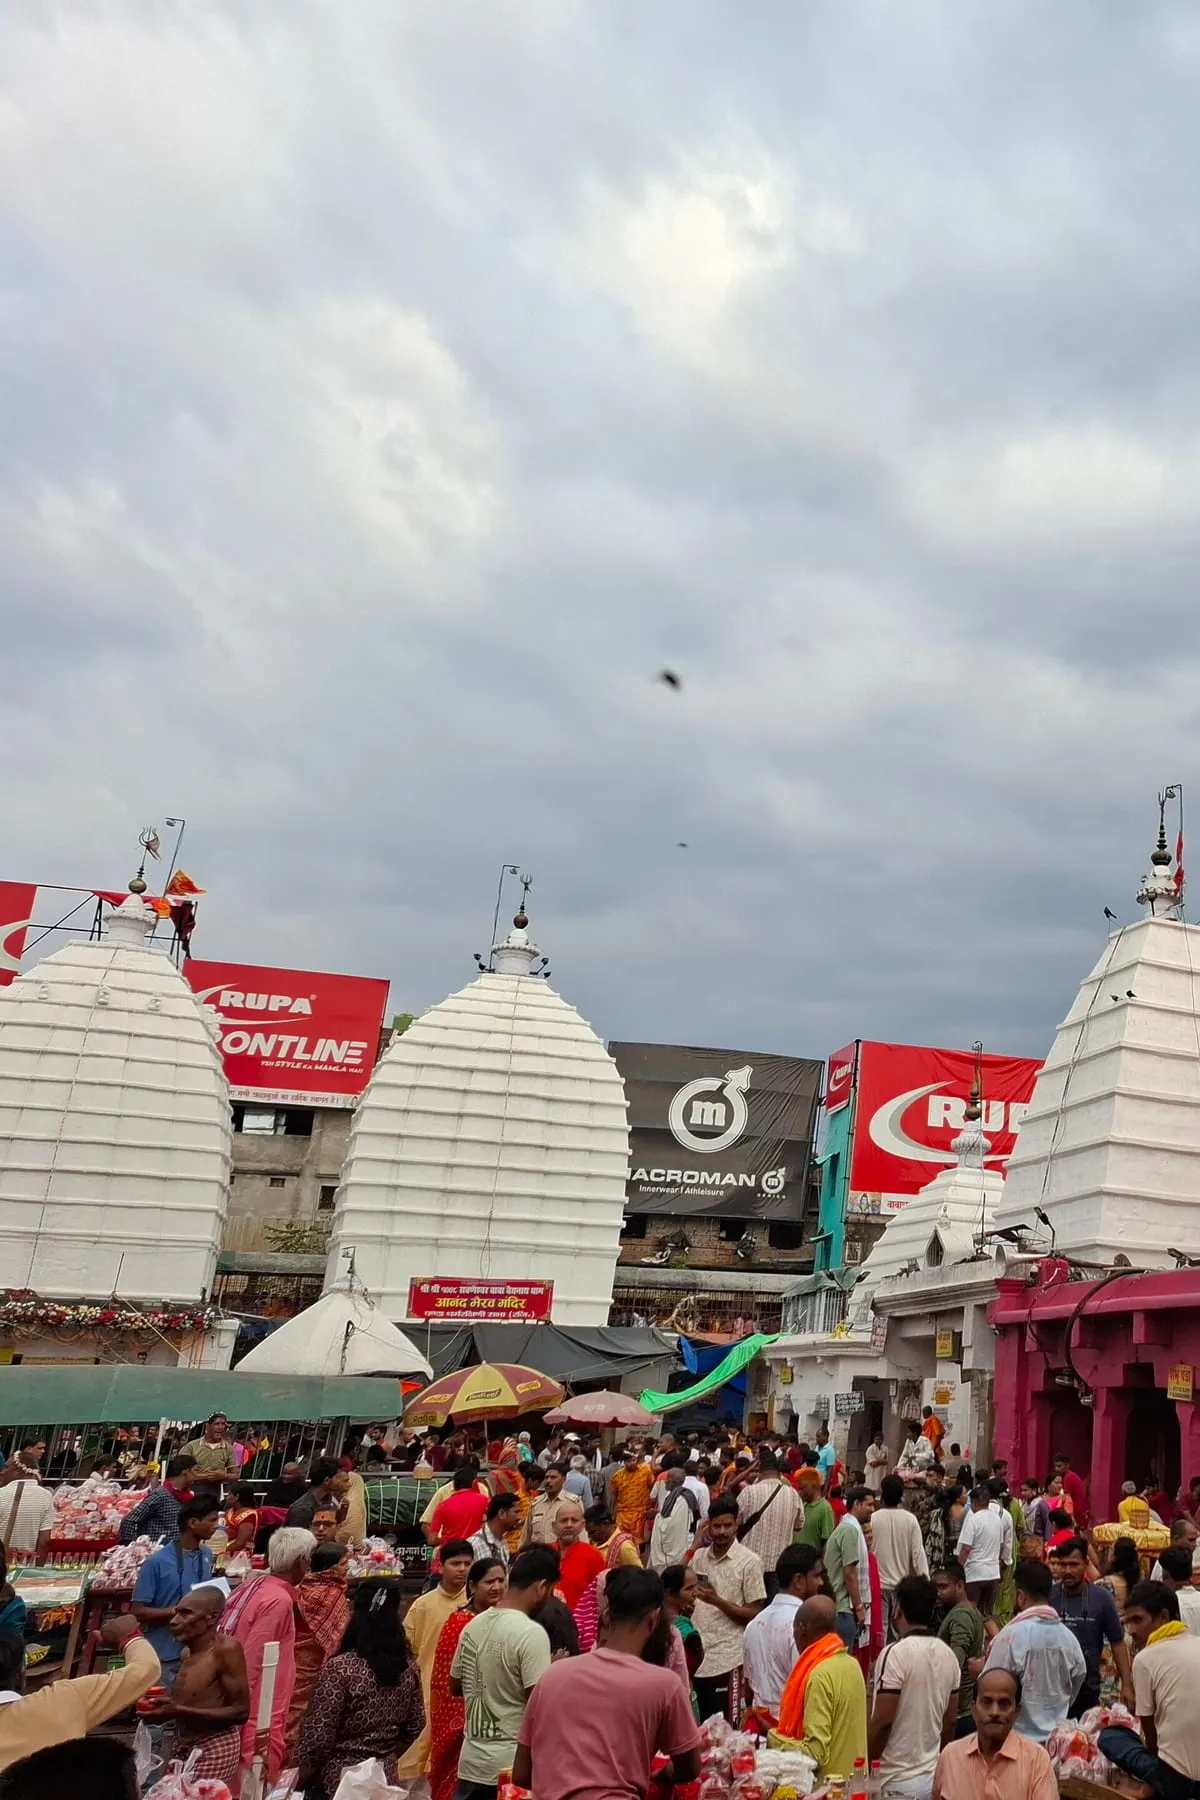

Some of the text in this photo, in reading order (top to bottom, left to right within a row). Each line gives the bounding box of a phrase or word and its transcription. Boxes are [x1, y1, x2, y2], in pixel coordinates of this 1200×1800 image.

[219, 990, 312, 1014] RUPA
[275, 1061, 302, 1069] STYLE
[314, 1064, 346, 1072] MAMLA
[630, 1168, 756, 1187] ACROMAN
[639, 1184, 679, 1194] Innerwear
[685, 1186, 725, 1196] Athleisure
[434, 1295, 467, 1308] आनंद
[498, 1295, 528, 1309] मंदिर
